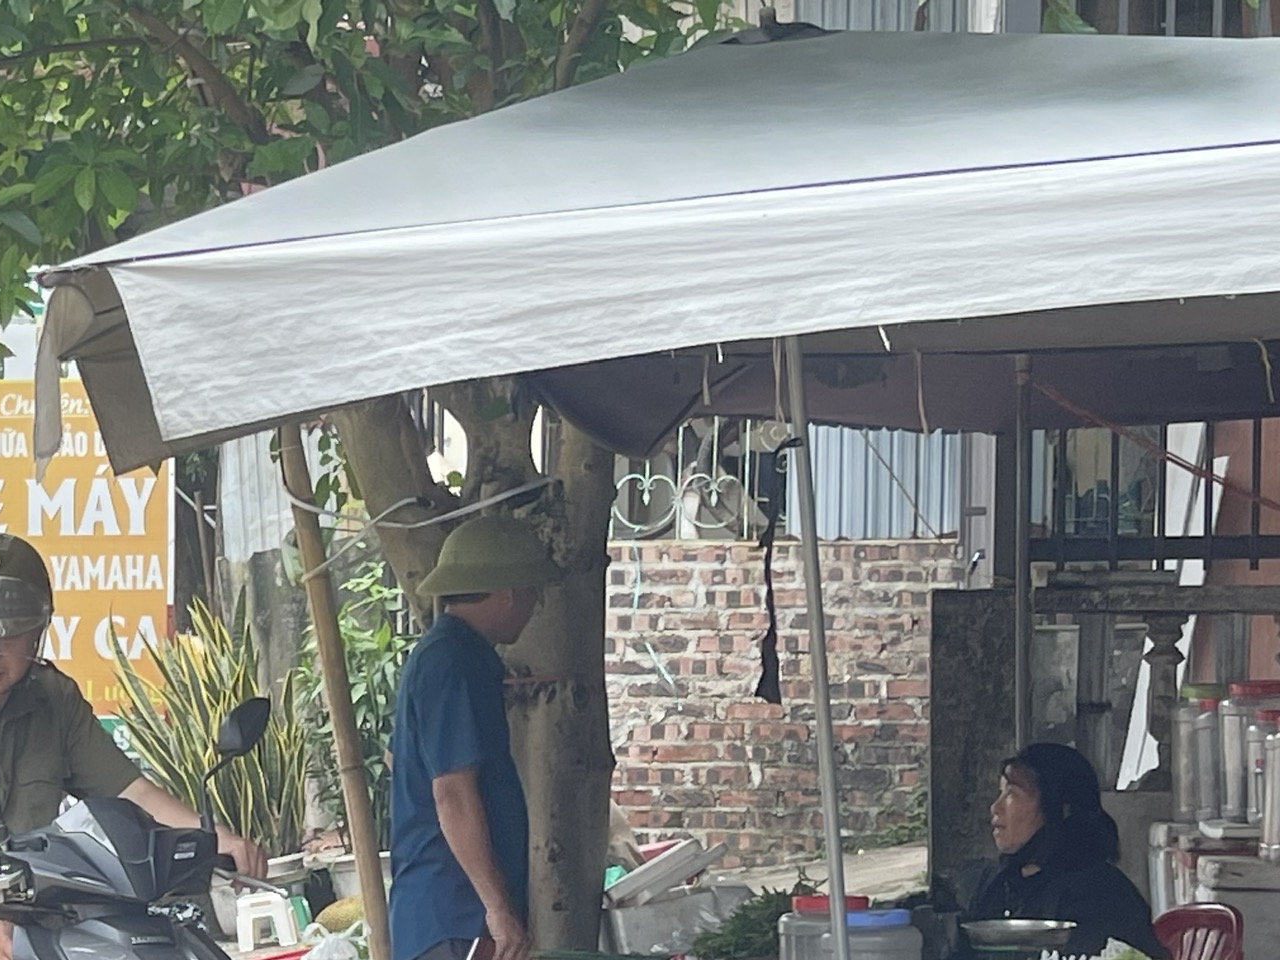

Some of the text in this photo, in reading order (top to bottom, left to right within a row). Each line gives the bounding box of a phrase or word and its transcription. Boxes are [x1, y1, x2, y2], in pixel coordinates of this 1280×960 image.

[0, 392, 91, 416] Chuên:
[52, 423, 89, 458] ẢO
[24, 464, 159, 538] MÁY
[49, 554, 165, 591] YAMAHA
[93, 615, 161, 661] GA
